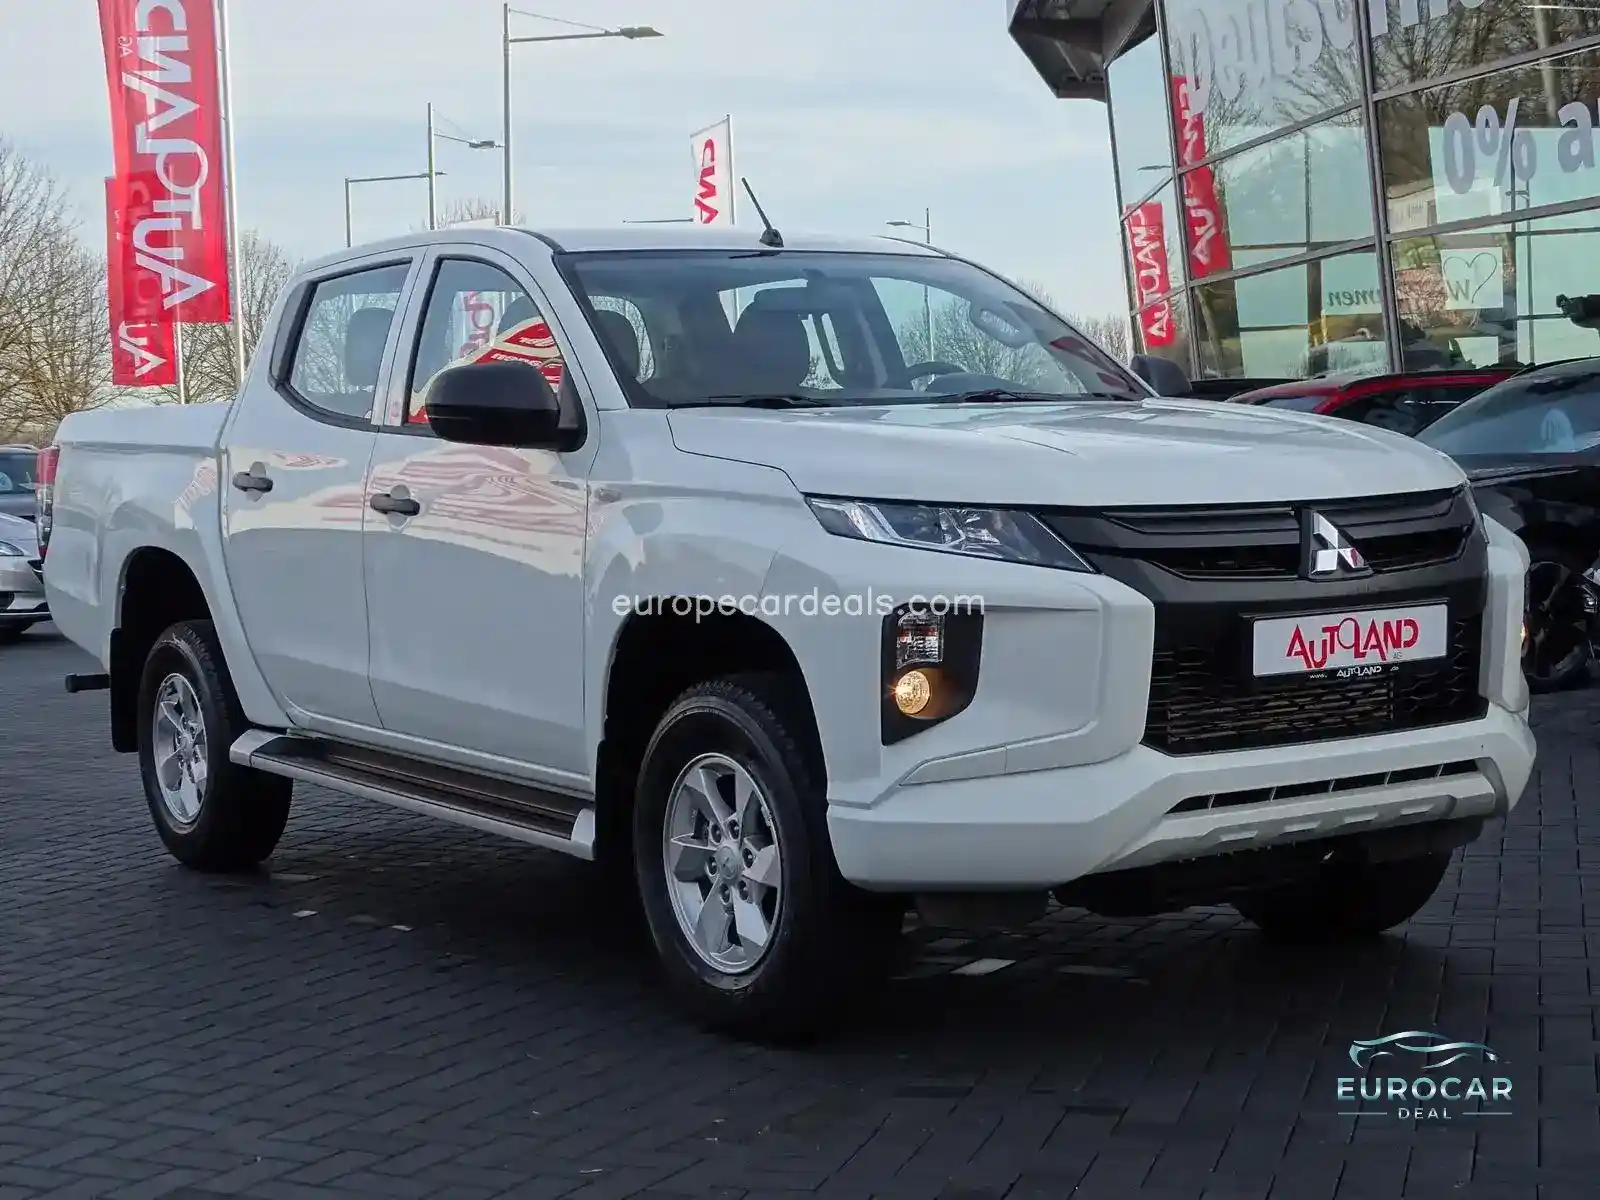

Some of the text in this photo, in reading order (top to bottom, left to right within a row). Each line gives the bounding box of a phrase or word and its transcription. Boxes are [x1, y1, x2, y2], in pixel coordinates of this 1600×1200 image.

[1443, 98, 1600, 194] 0% a
[1286, 617, 1419, 668] AUTOLAND
